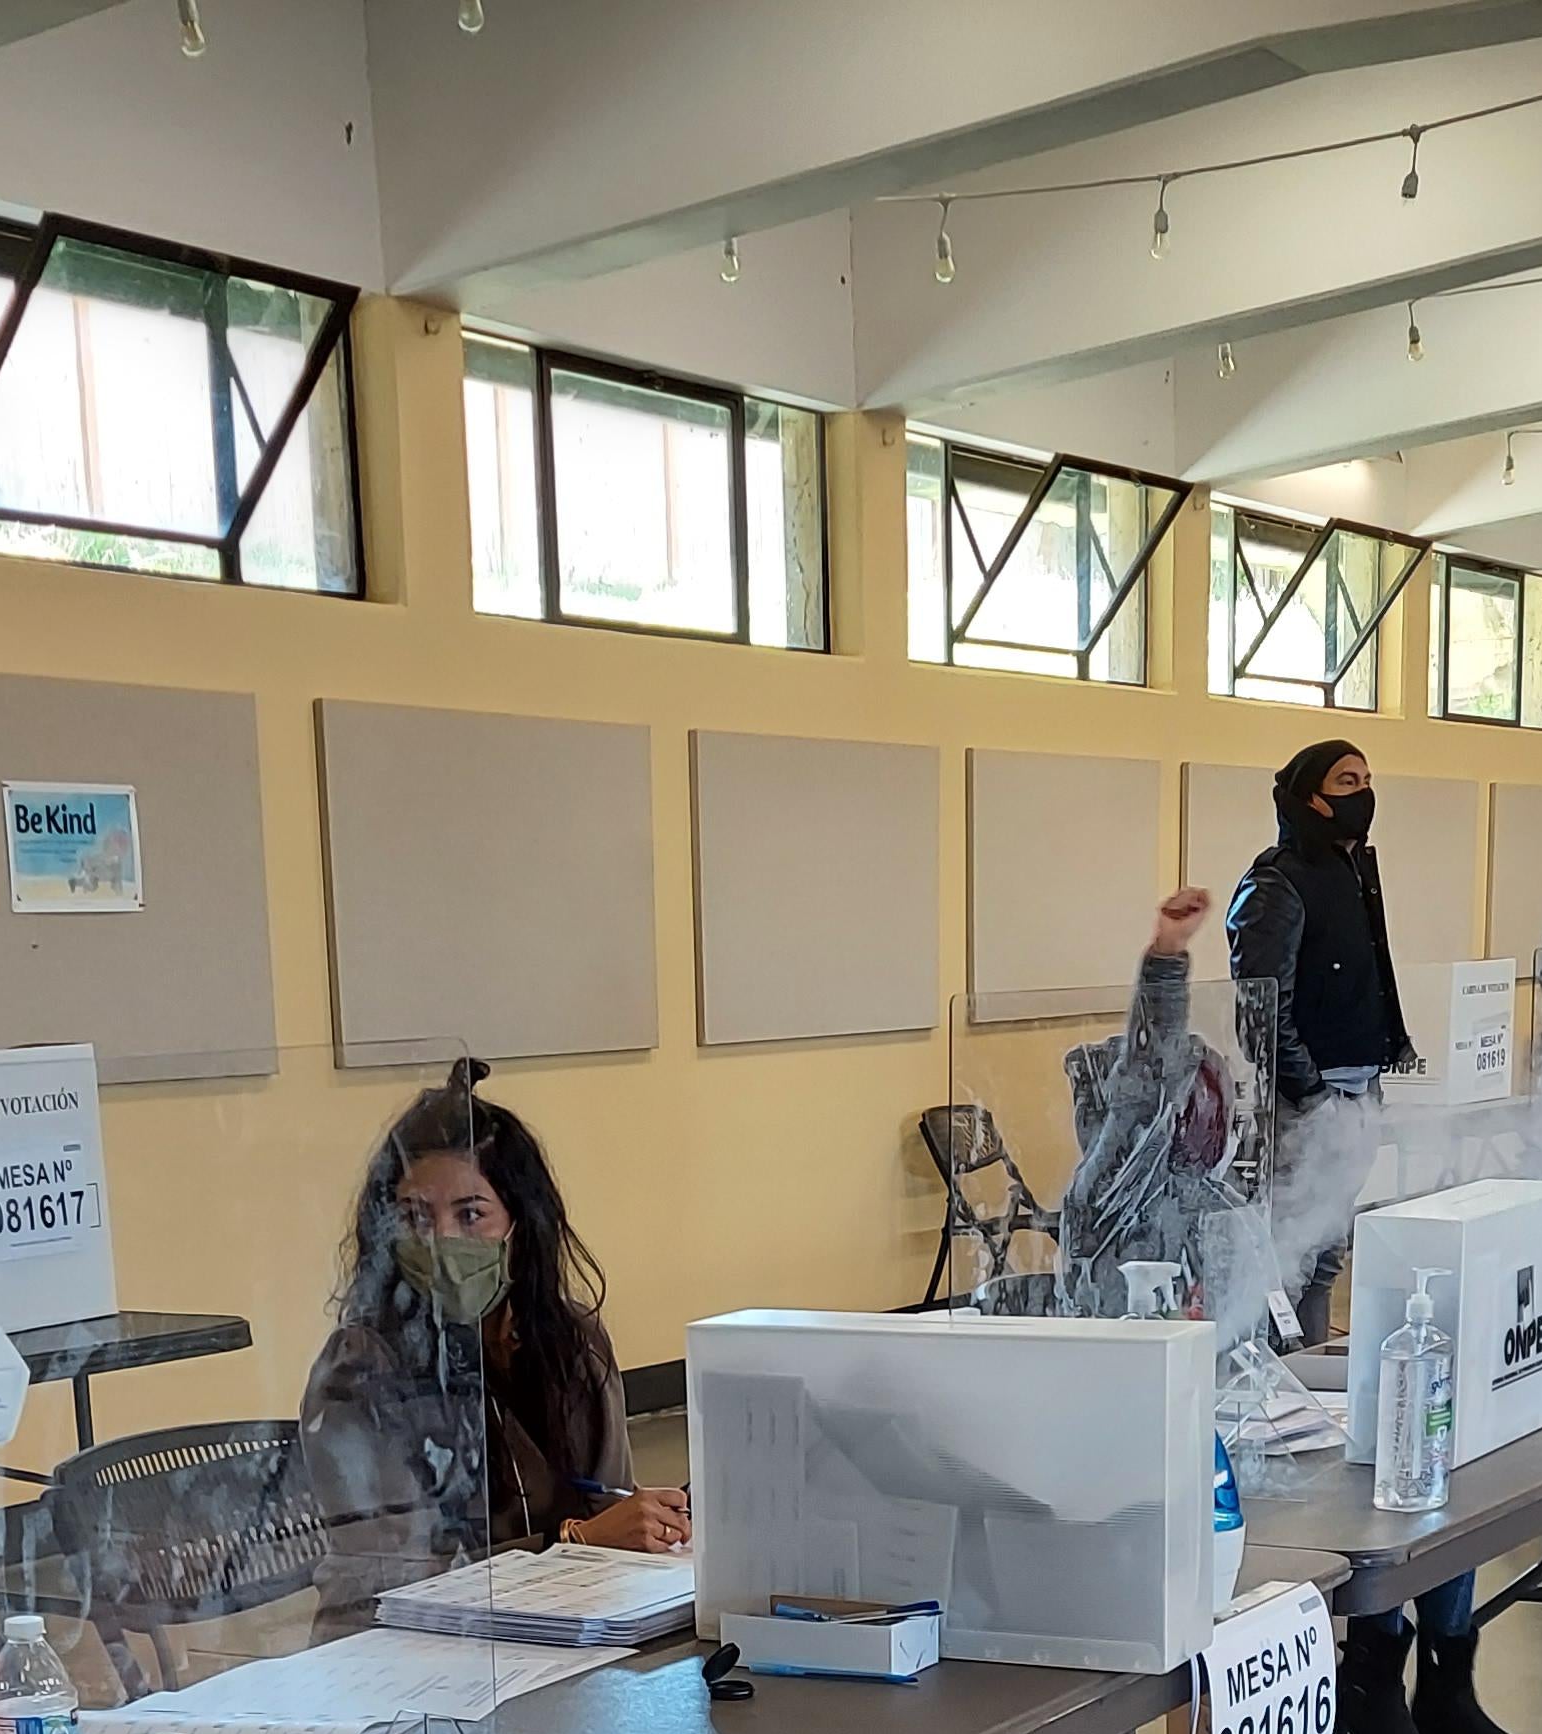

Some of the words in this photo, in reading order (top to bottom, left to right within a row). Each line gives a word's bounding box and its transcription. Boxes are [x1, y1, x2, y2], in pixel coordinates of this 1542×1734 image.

[14, 803, 43, 833] Be
[45, 802, 96, 835] Kind
[1476, 1048, 1505, 1071] 081619
[0, 1087, 80, 1117] VOTACIÓN
[1226, 1642, 1292, 1707] MESA
